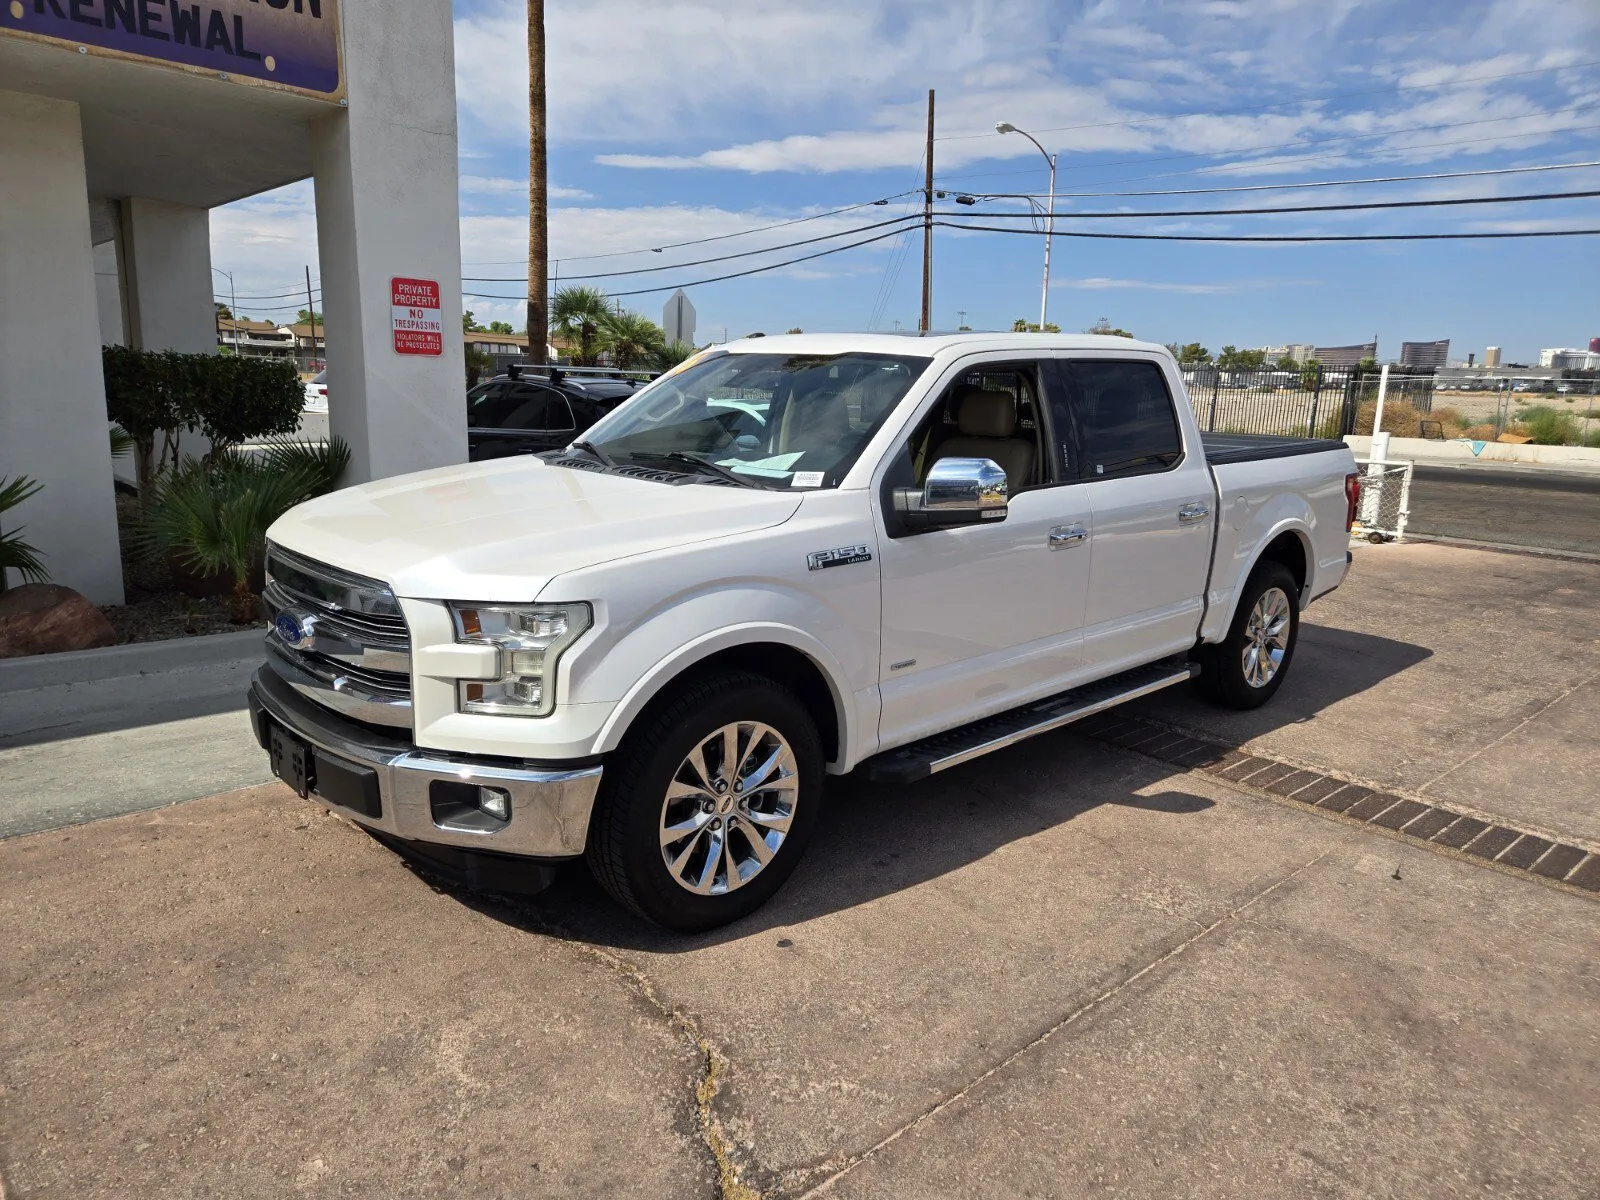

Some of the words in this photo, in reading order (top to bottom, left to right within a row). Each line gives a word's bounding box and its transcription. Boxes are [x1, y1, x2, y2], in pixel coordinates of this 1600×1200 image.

[398, 284, 432, 296] PRIVATE
[394, 294, 436, 306] PROPERTY
[409, 309, 424, 319] NO
[394, 319, 440, 331] TRESPASSING
[396, 333, 425, 341] VIOLATORS
[405, 342, 440, 350] PROSECUTED
[847, 555, 870, 564] LARIAT
